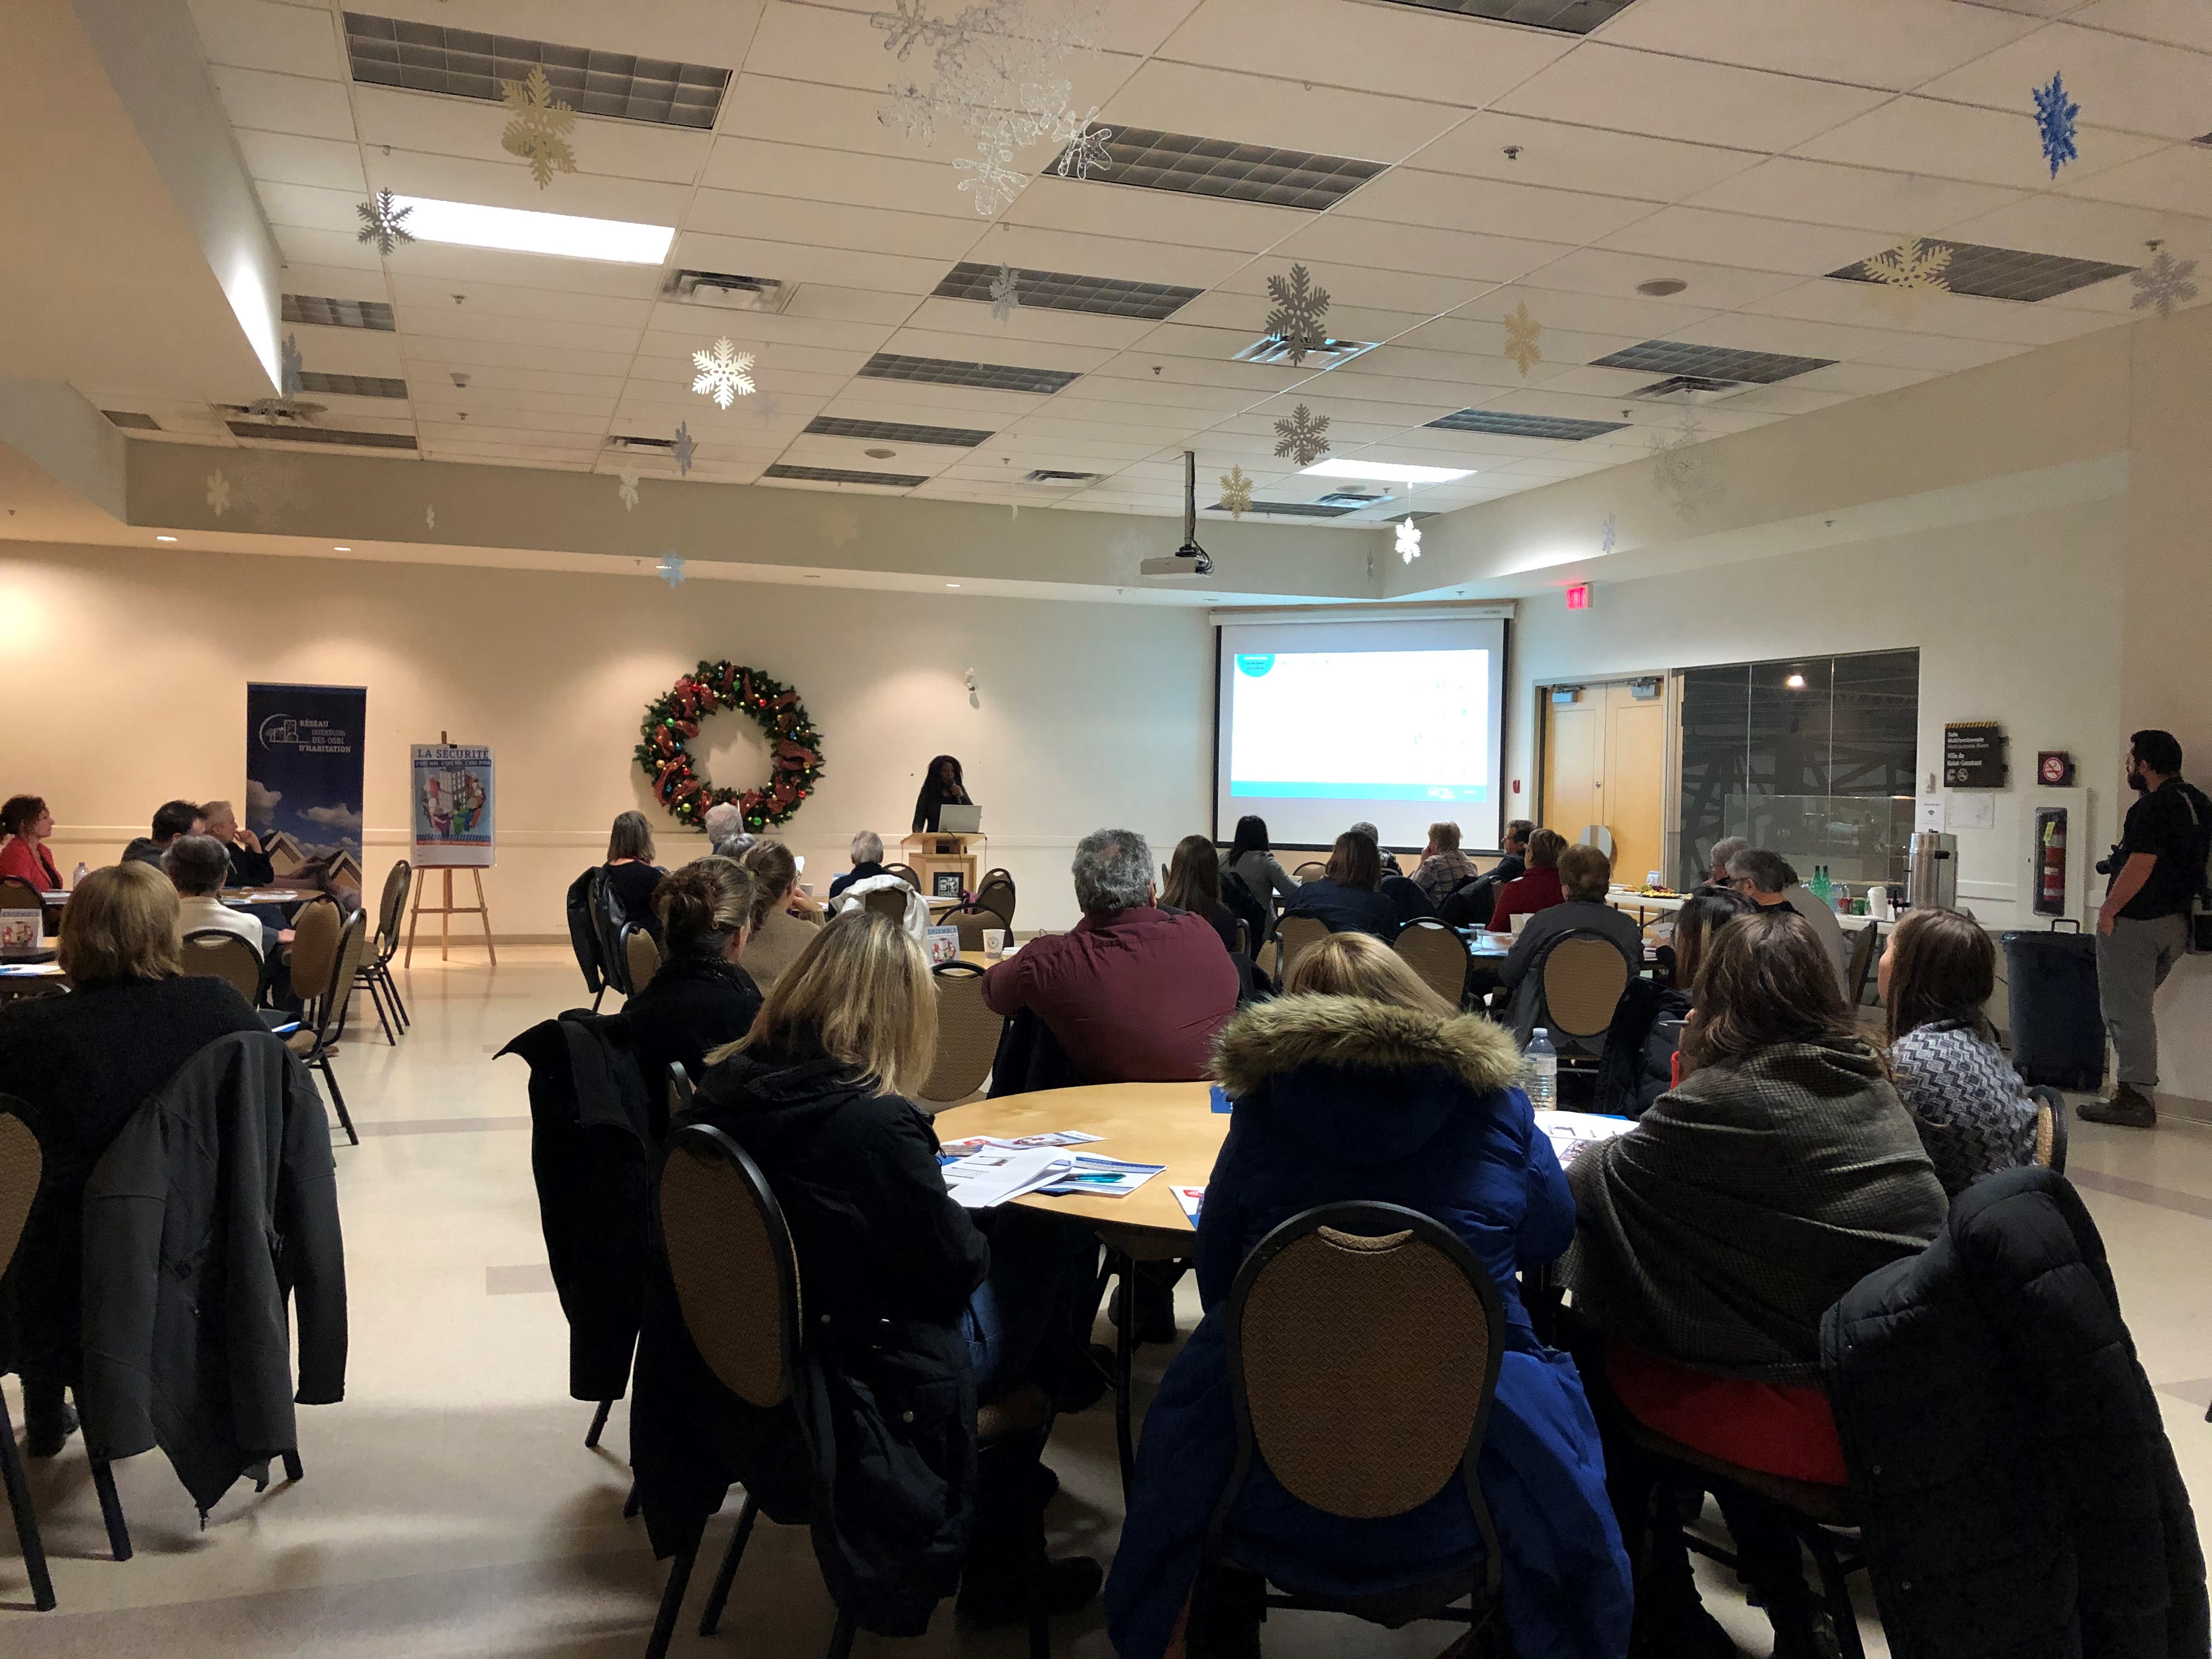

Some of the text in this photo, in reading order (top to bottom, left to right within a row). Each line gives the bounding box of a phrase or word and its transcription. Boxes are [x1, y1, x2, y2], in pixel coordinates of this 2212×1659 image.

[300, 718, 329, 727] RÉSEAU
[312, 729, 346, 737] QUÉBÉCOIS
[299, 744, 352, 753] D'HABITATION
[417, 747, 489, 759] LA SÉCURITÉ
